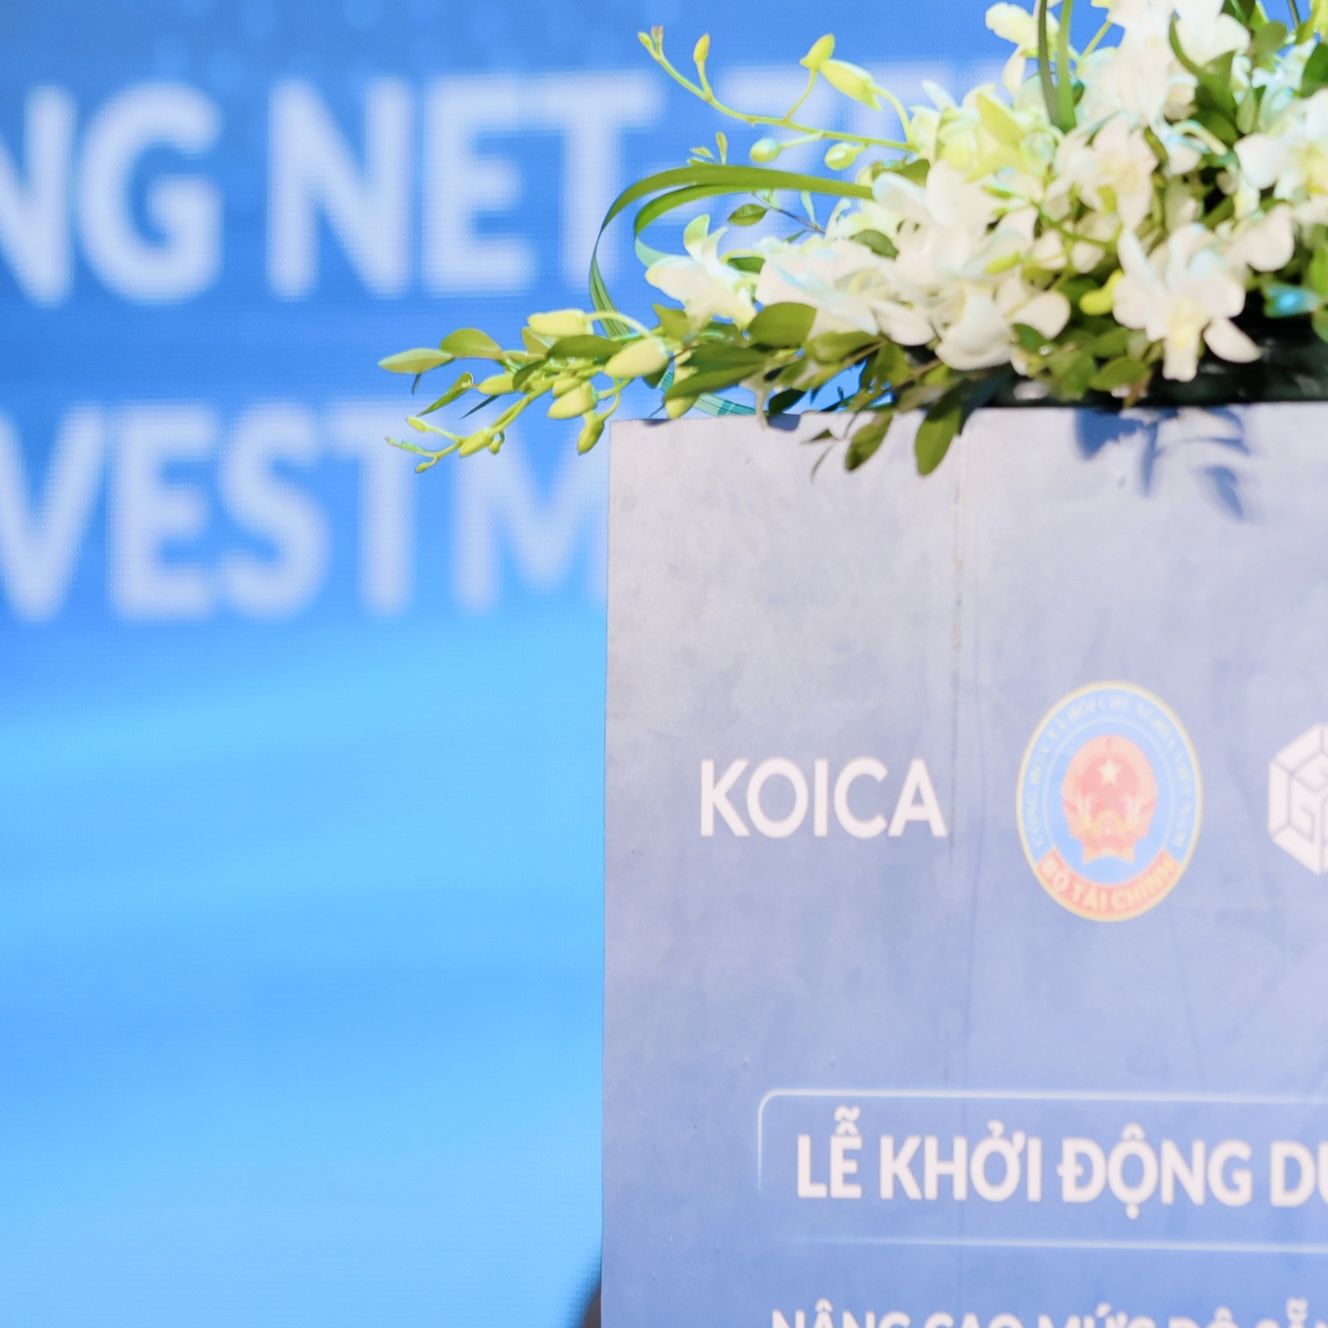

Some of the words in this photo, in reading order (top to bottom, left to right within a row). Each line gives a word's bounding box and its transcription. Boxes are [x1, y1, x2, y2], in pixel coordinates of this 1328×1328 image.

[700, 757, 948, 838] KOICA
[797, 1104, 863, 1199] LỄ
[879, 1119, 1042, 1202] KHỞI
[1056, 1123, 1252, 1220] ĐỘNG
